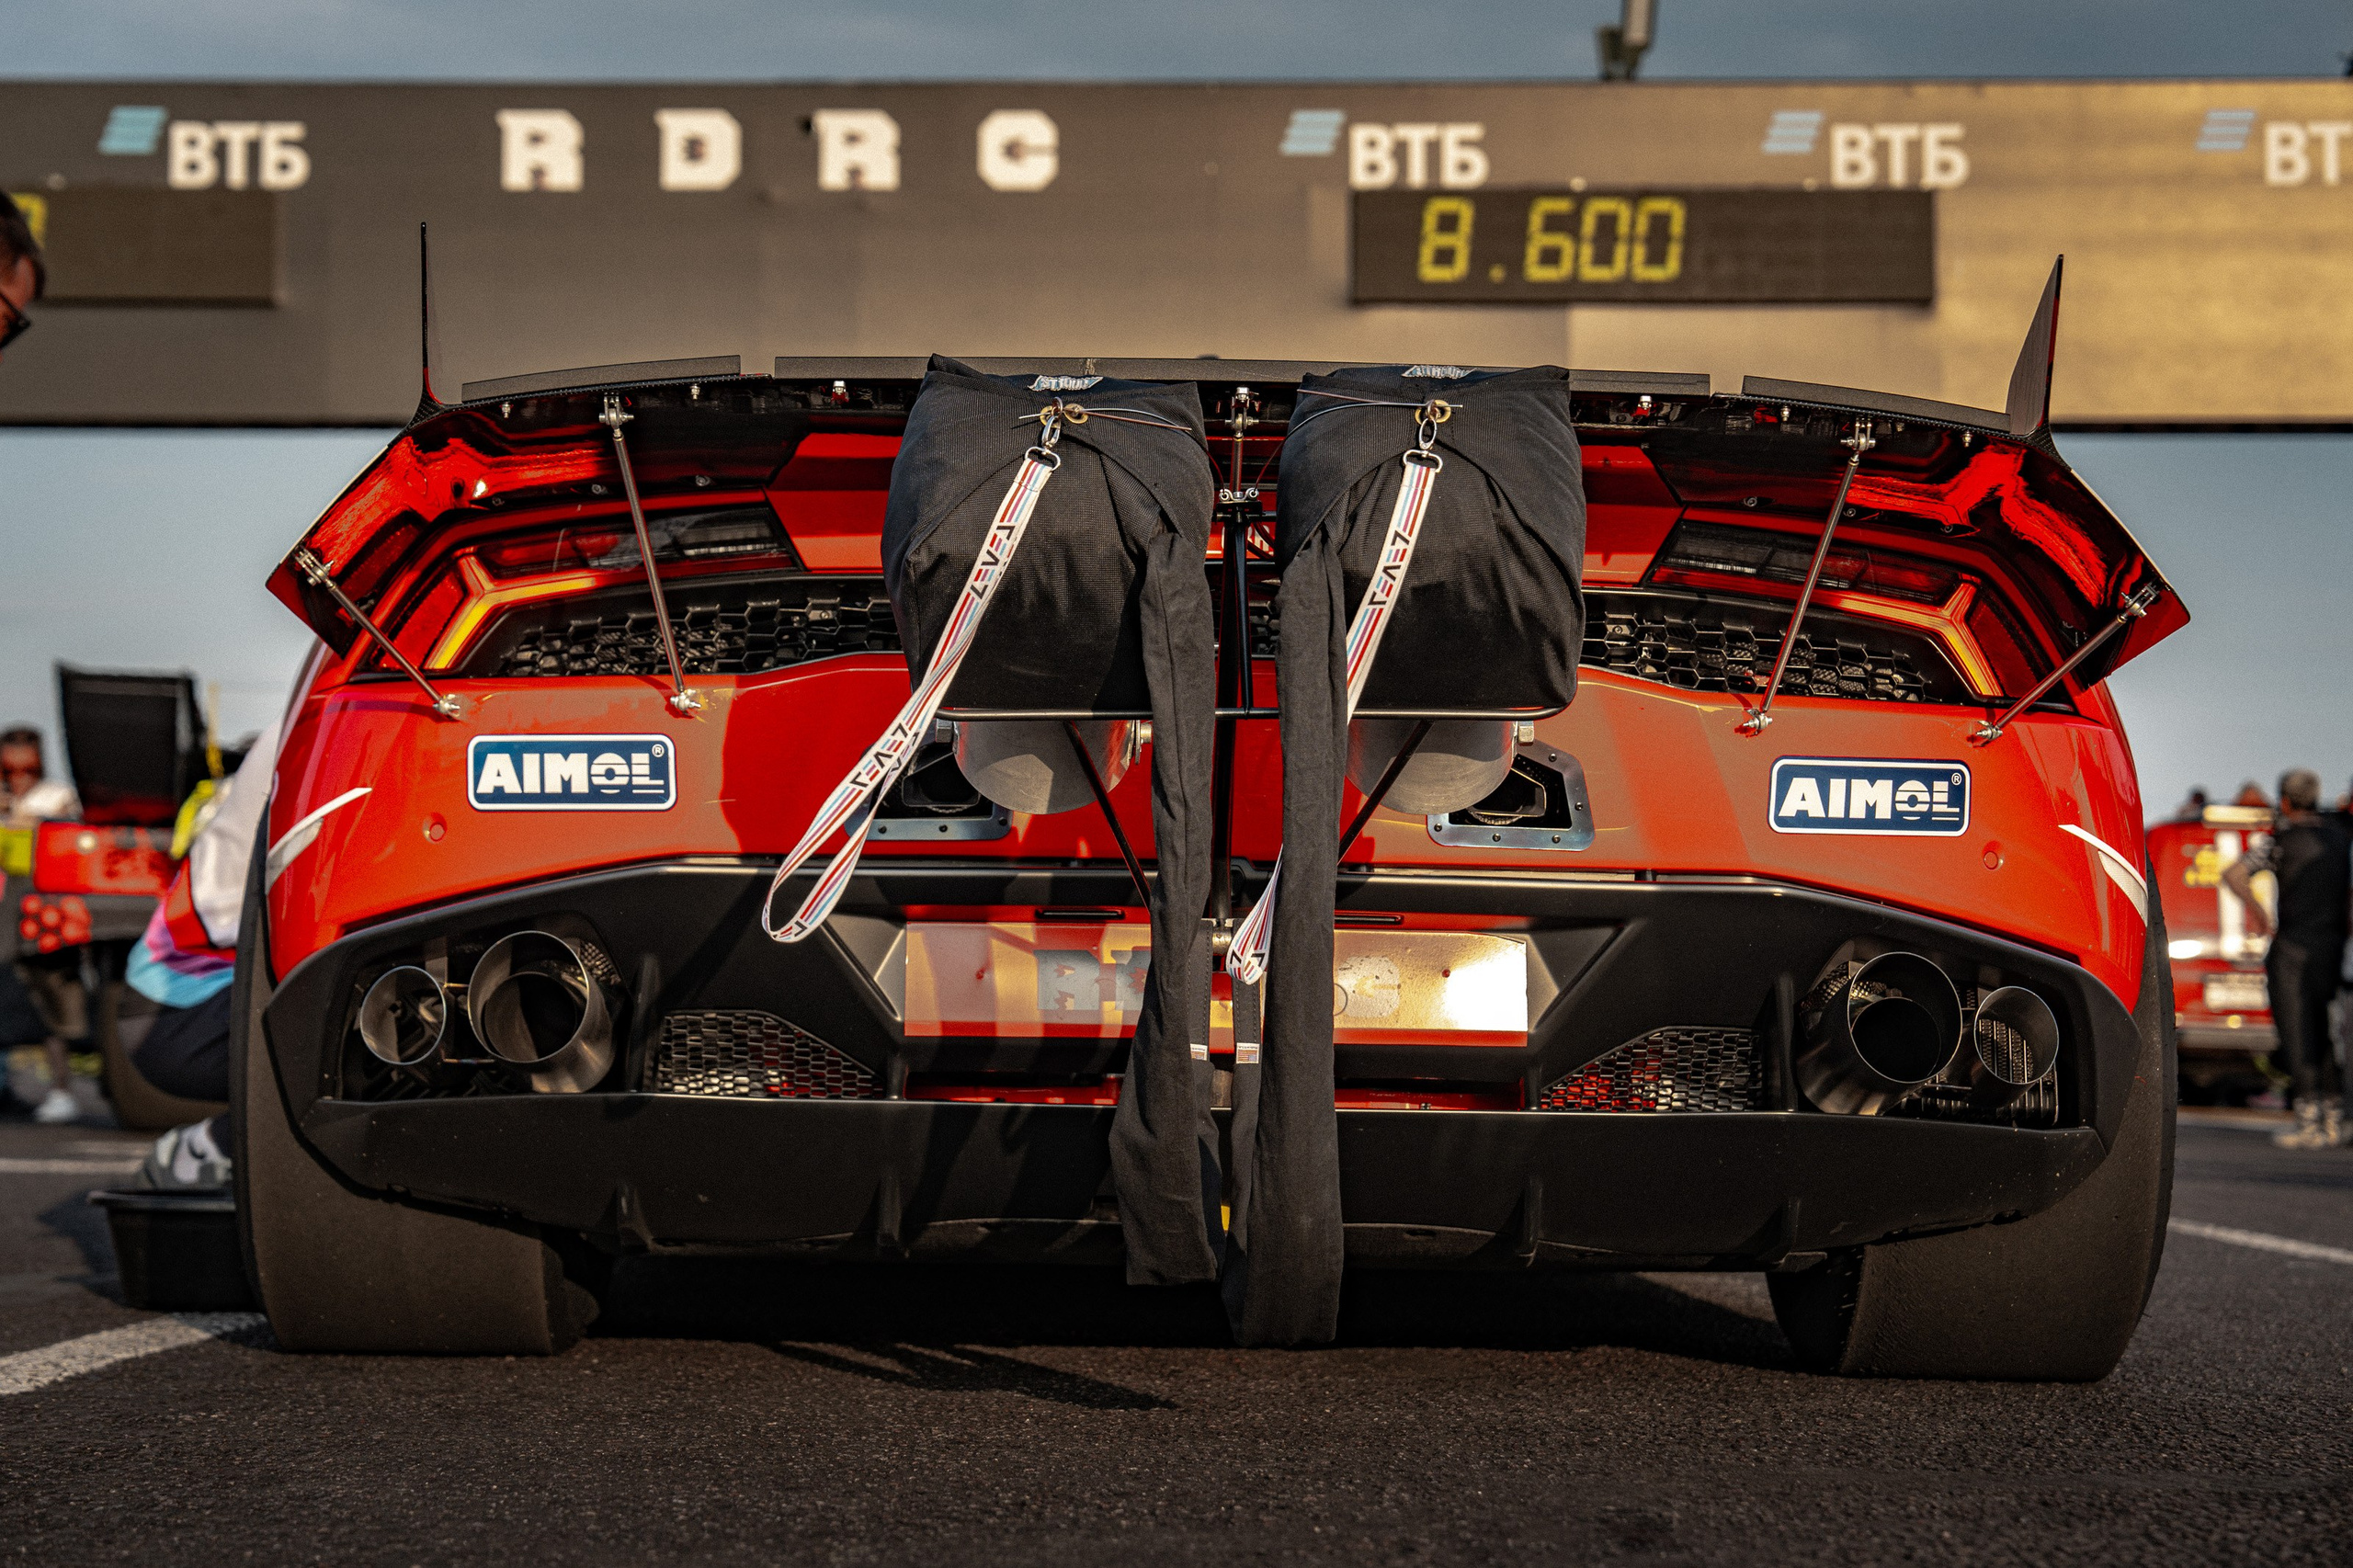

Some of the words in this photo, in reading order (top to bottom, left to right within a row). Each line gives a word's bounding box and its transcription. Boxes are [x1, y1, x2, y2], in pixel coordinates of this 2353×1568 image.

[165, 121, 312, 191] ВТБ
[1347, 121, 1491, 189] ВТБ
[1829, 122, 1972, 189] ВТБ
[1418, 197, 1686, 283] 8.600
